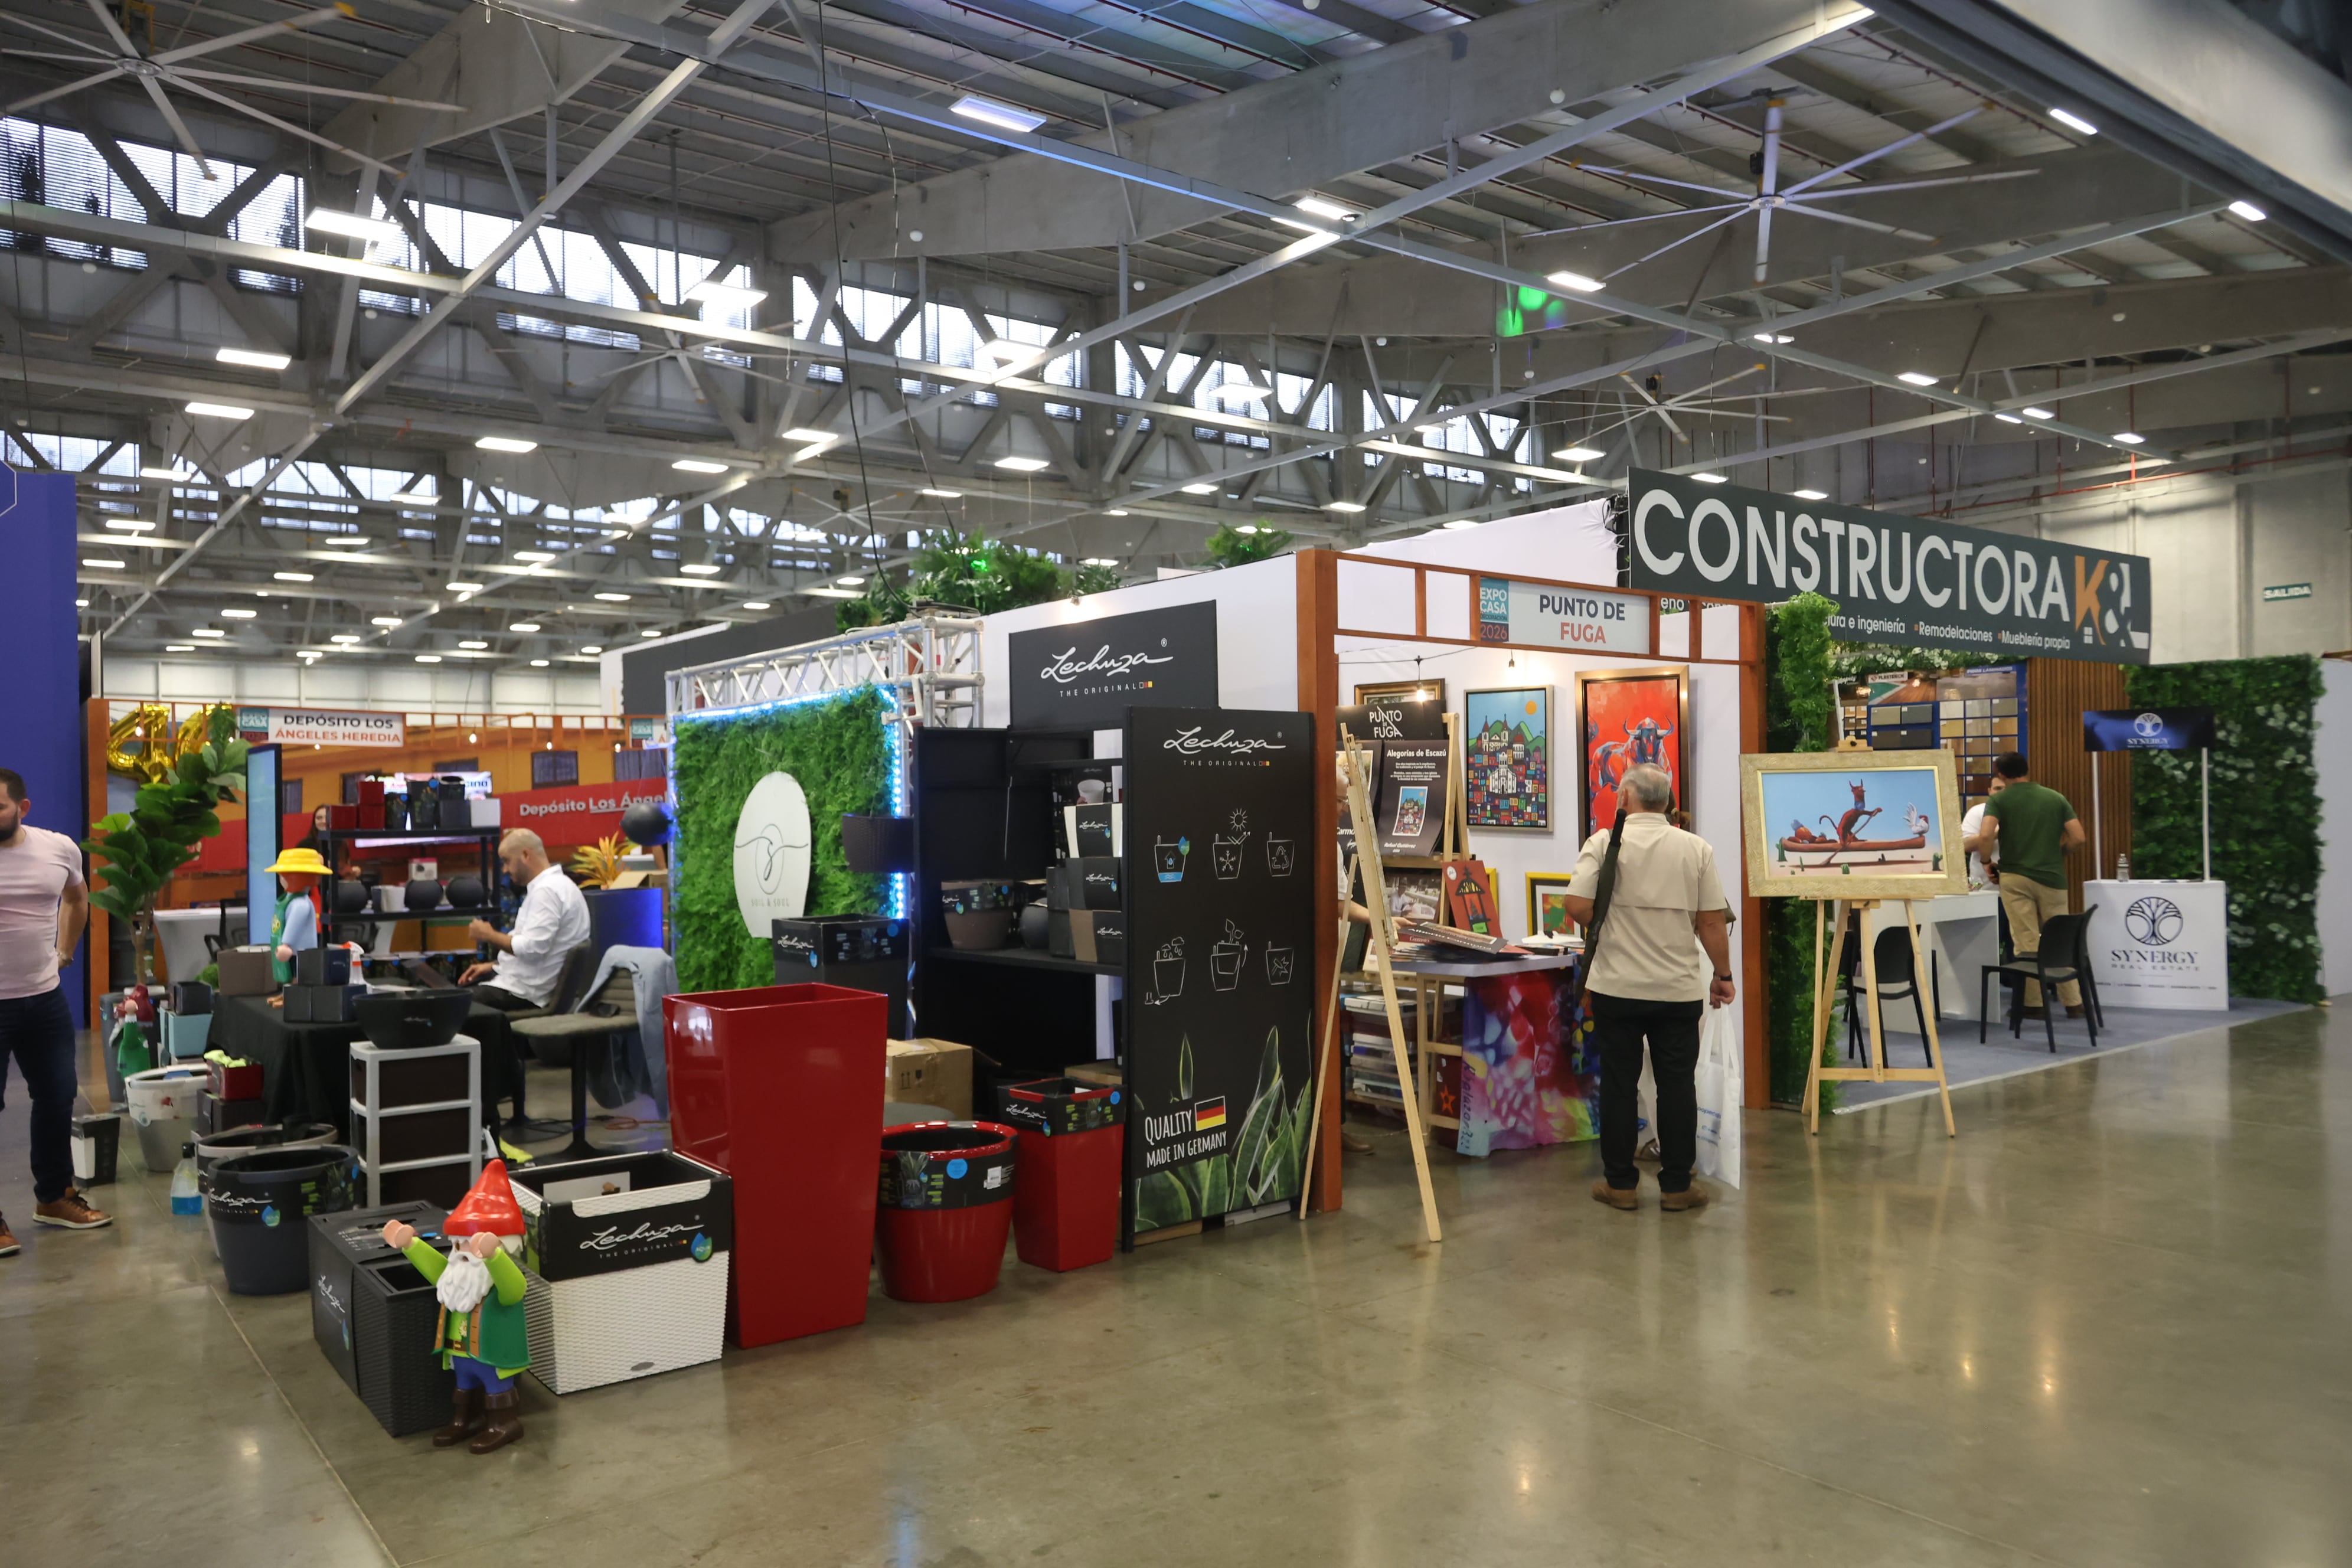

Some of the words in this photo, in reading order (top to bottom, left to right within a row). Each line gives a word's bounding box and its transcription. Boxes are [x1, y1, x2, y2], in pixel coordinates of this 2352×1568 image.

[1634, 489, 2070, 622] CONSTRUCTORA
[1480, 587, 1507, 602] EXPO
[2263, 586, 2311, 599] SALIDA
[1480, 600, 1507, 615] CASA
[1540, 594, 1599, 618] PUNTO
[1603, 602, 1625, 620] DE
[1480, 624, 1507, 640] 2026
[1560, 622, 1606, 643] FUGA
[1848, 617, 1856, 629] e
[1857, 615, 1906, 634] ingeniería
[1919, 622, 1993, 642] Remodelaciones
[2001, 630, 2043, 647] Mueblería
[2044, 636, 2070, 651] propia
[1041, 645, 1174, 683] Lechuza
[1084, 682, 1137, 695] ORIGINAL
[284, 713, 361, 728] DEPÓSITO
[365, 718, 394, 729] LOS
[1369, 705, 1403, 723] PUNTO
[275, 728, 338, 741] ÁNGELES
[342, 731, 401, 742] HEREDIA
[1164, 726, 1286, 754] Lechuza
[1374, 726, 1403, 739] FUGA
[1387, 749, 1415, 759] Alegorías
[1416, 749, 1425, 757] de
[1425, 749, 1447, 757] Escazú
[520, 799, 586, 817] Depósito
[589, 797, 616, 809] Los
[773, 897, 790, 907] SOUL
[2111, 949, 2199, 964] SYNERGY
[1145, 1109, 1192, 1146] QUALITY
[1146, 1146, 1171, 1168] MADE
[1173, 1142, 1185, 1161] IN
[1187, 1131, 1227, 1157] GERMANY
[579, 1222, 705, 1250] Lechuza
[599, 1251, 618, 1259] THE
[623, 1243, 674, 1255] ORIGINAL
